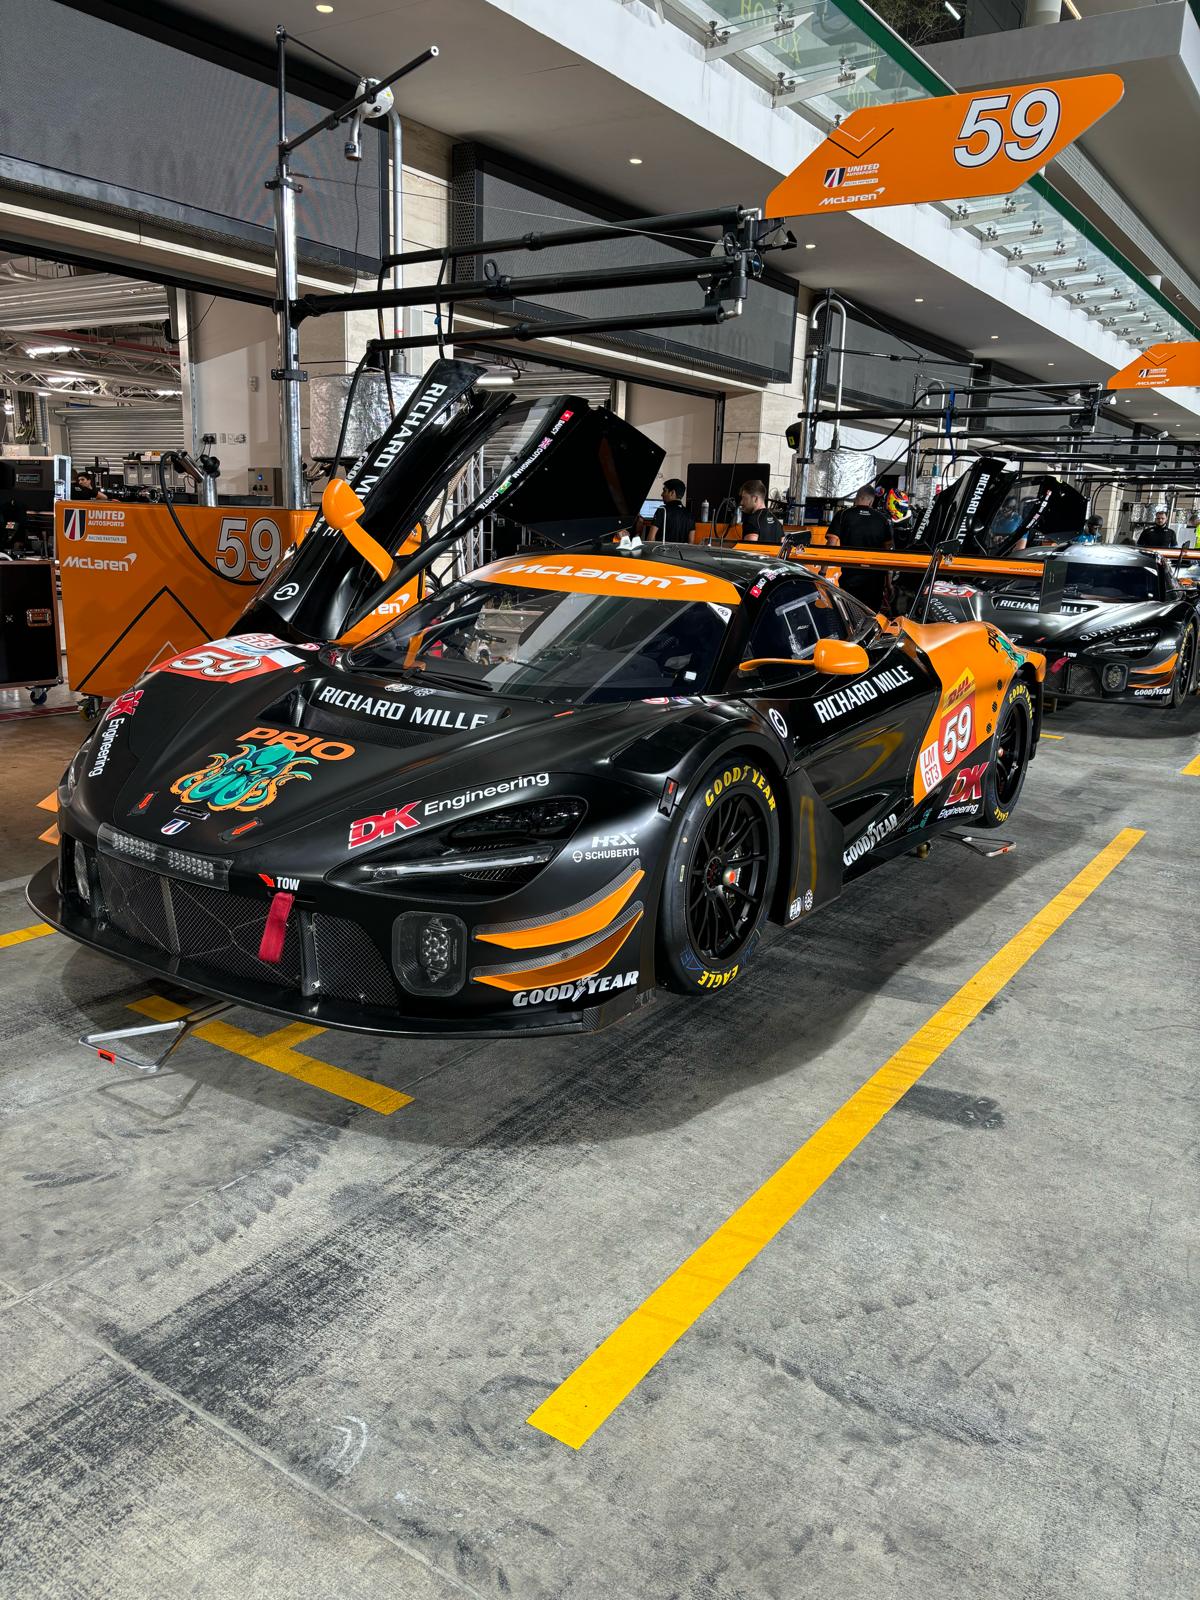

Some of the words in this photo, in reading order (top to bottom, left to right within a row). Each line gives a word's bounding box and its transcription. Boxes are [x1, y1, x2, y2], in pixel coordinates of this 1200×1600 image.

[953, 87, 1062, 169] 59
[847, 163, 880, 173] UNITED
[818, 193, 878, 207] McLaren
[373, 382, 448, 468] RICHARD
[511, 447, 544, 479] COTTINGHAM
[479, 490, 500, 510] COSTA
[966, 473, 991, 515] RICHARD
[87, 520, 125, 528] AUTOSPORTS
[88, 509, 126, 521] UNITED
[216, 517, 282, 581] 59
[63, 556, 129, 572] McLaren
[496, 564, 673, 589] McLaren
[1000, 599, 1039, 611] RICHAR
[168, 651, 263, 677] 59
[813, 680, 879, 724] RICHARD
[872, 665, 915, 694] MILLE
[946, 676, 970, 706] DHL
[1134, 688, 1172, 697] GOODYEAR
[318, 686, 406, 721] RICHARD
[409, 706, 489, 731] MILLE
[235, 727, 356, 761] PRIO
[942, 704, 973, 764] 59
[88, 717, 126, 778] Engineering
[922, 747, 936, 769] LM
[705, 765, 777, 812] GOODYEAR
[924, 763, 941, 788] GT3
[943, 761, 990, 807] DK
[348, 800, 424, 850] DK
[424, 772, 550, 816] Engineering
[937, 803, 980, 820] Engineering
[591, 832, 638, 849] HRX
[842, 813, 899, 867] GOODYEAR
[584, 847, 640, 860] SCHUBERTH
[276, 876, 300, 891] TOW
[512, 970, 640, 1007] GOODYEAR
[697, 964, 740, 989] EAGLE
